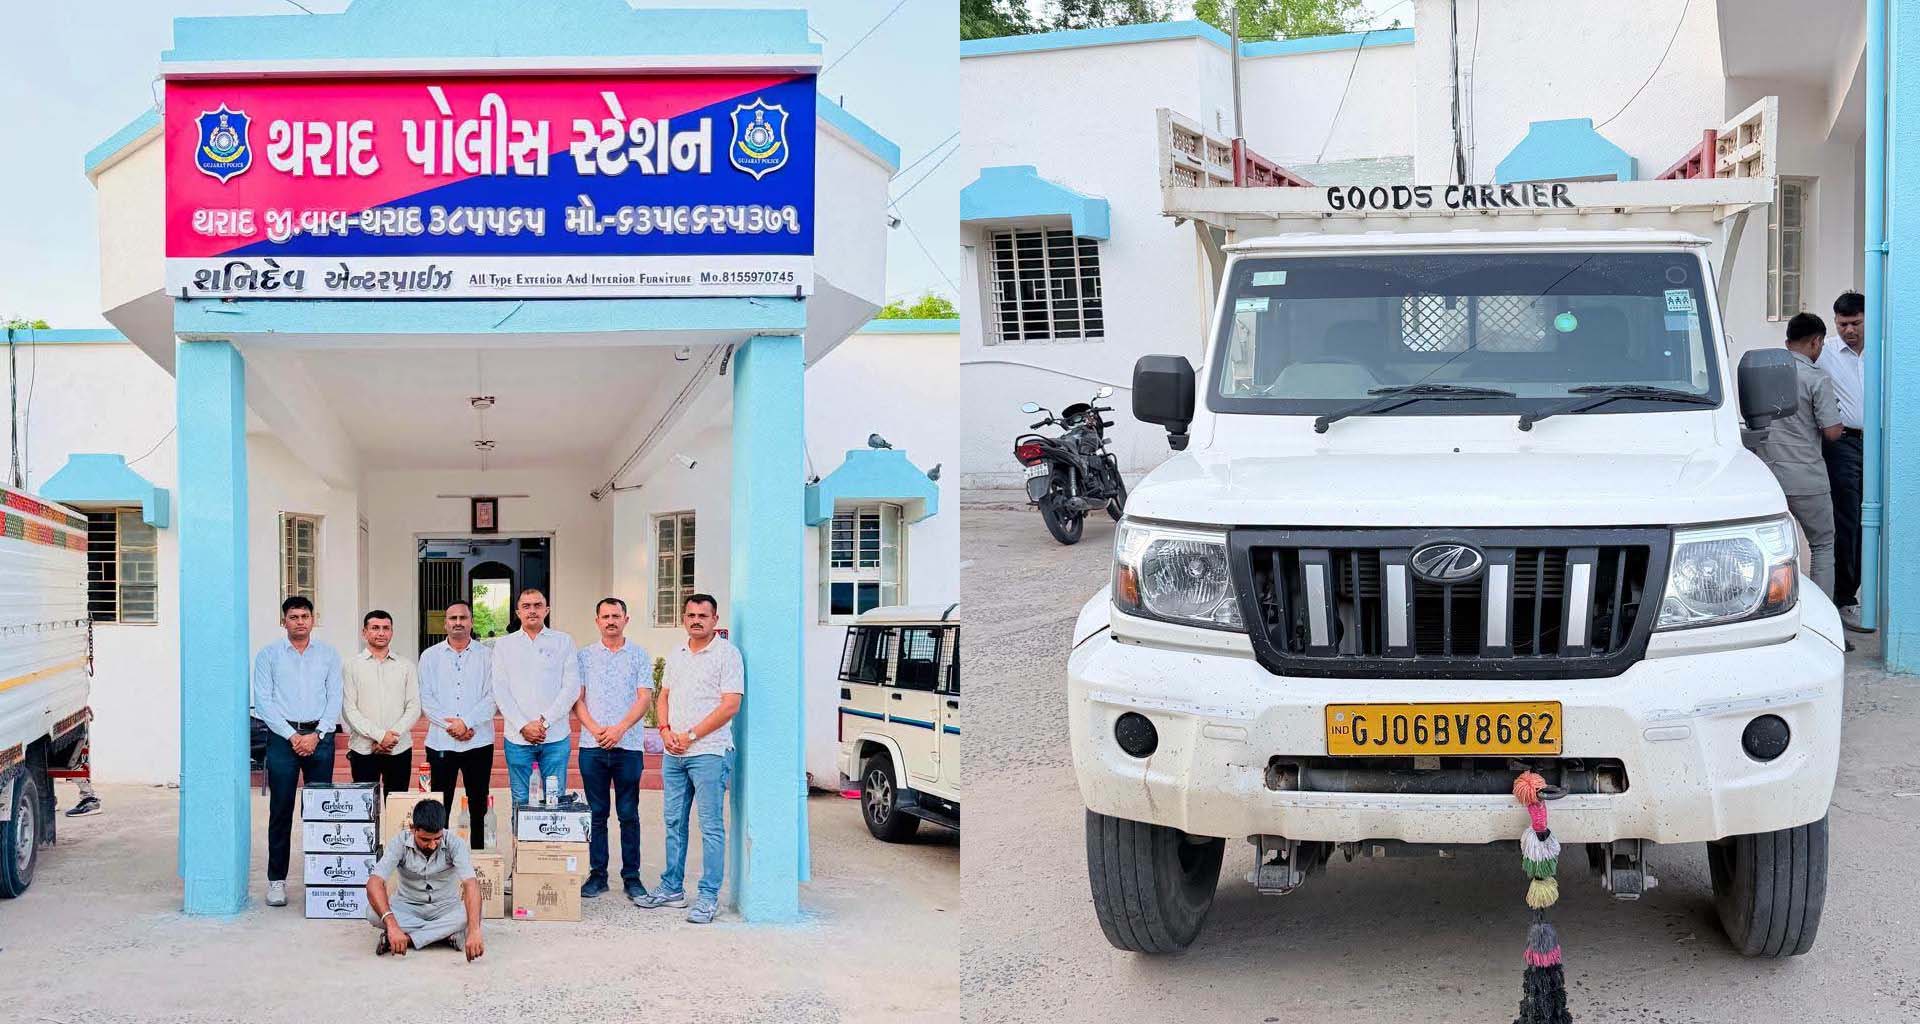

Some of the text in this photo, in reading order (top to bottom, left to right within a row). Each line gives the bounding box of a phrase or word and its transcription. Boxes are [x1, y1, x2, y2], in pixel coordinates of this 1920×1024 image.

[266, 85, 712, 177] થરાદ પોલીસ સ્ટેશન
[1327, 183, 1576, 211] GOODS CARRIER
[192, 208, 255, 236] થરાદ
[193, 258, 305, 291] શનિદેવ
[469, 273, 486, 285] All
[700, 271, 794, 283] Mo.8155970745
[1331, 713, 1555, 746] IND GJ06BV8682
[322, 801, 353, 813] Carlsberg
[539, 823, 571, 835] Carlsberg
[323, 834, 355, 846] Carlsberg
[324, 866, 355, 878] Carlsberg
[327, 899, 358, 912] Carlsberg
